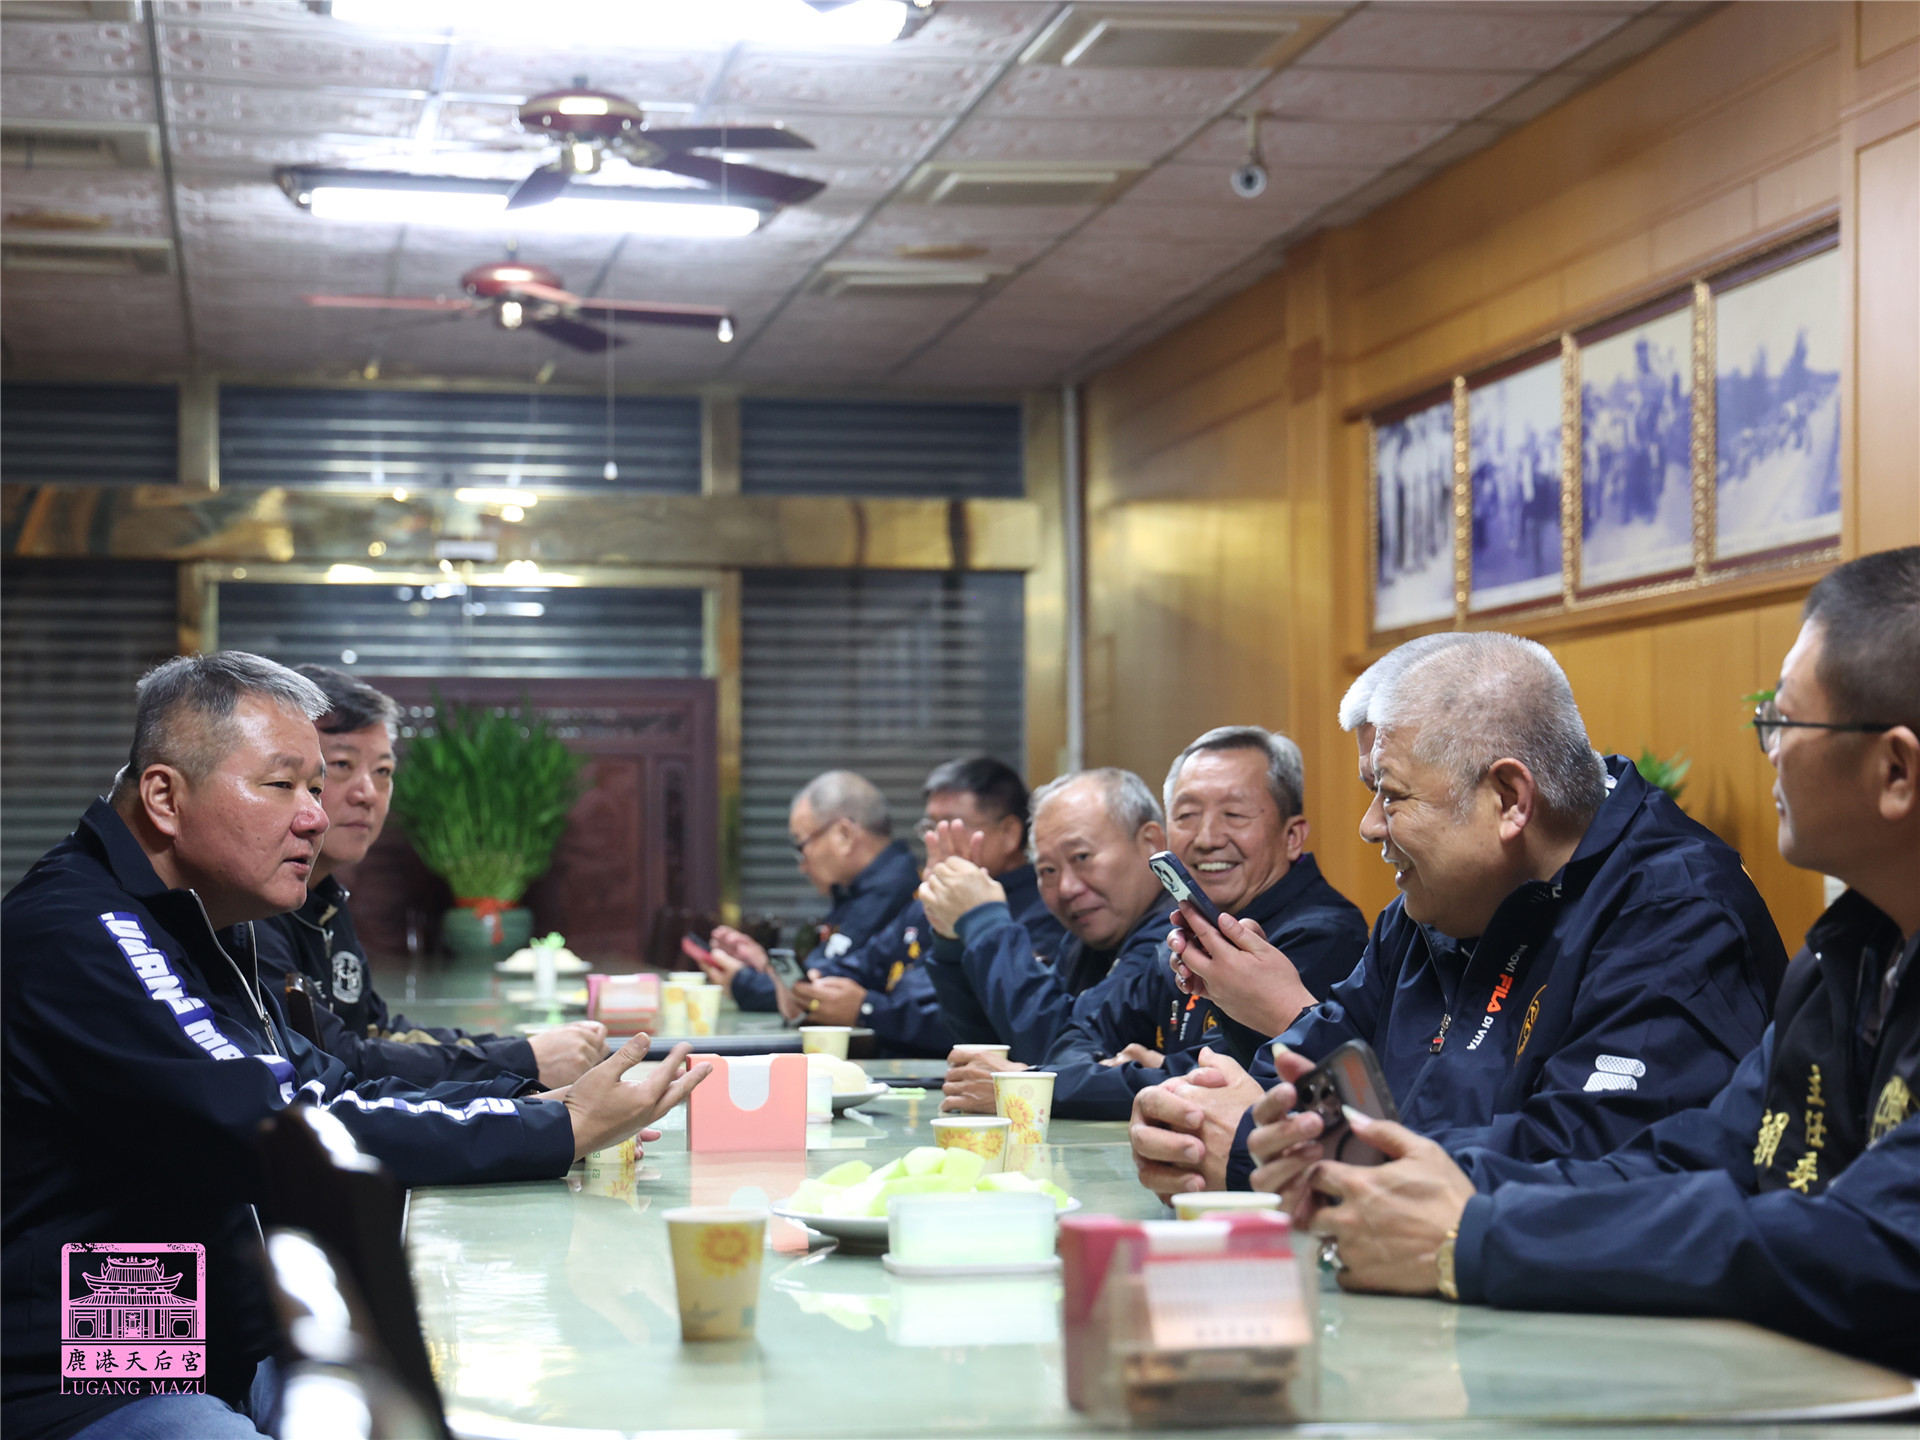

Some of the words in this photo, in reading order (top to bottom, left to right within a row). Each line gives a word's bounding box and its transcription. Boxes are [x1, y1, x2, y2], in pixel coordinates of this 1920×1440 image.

[1486, 973, 1514, 1013] FILA
[1481, 1015, 1494, 1030] DI
[1466, 1028, 1488, 1050] VITA
